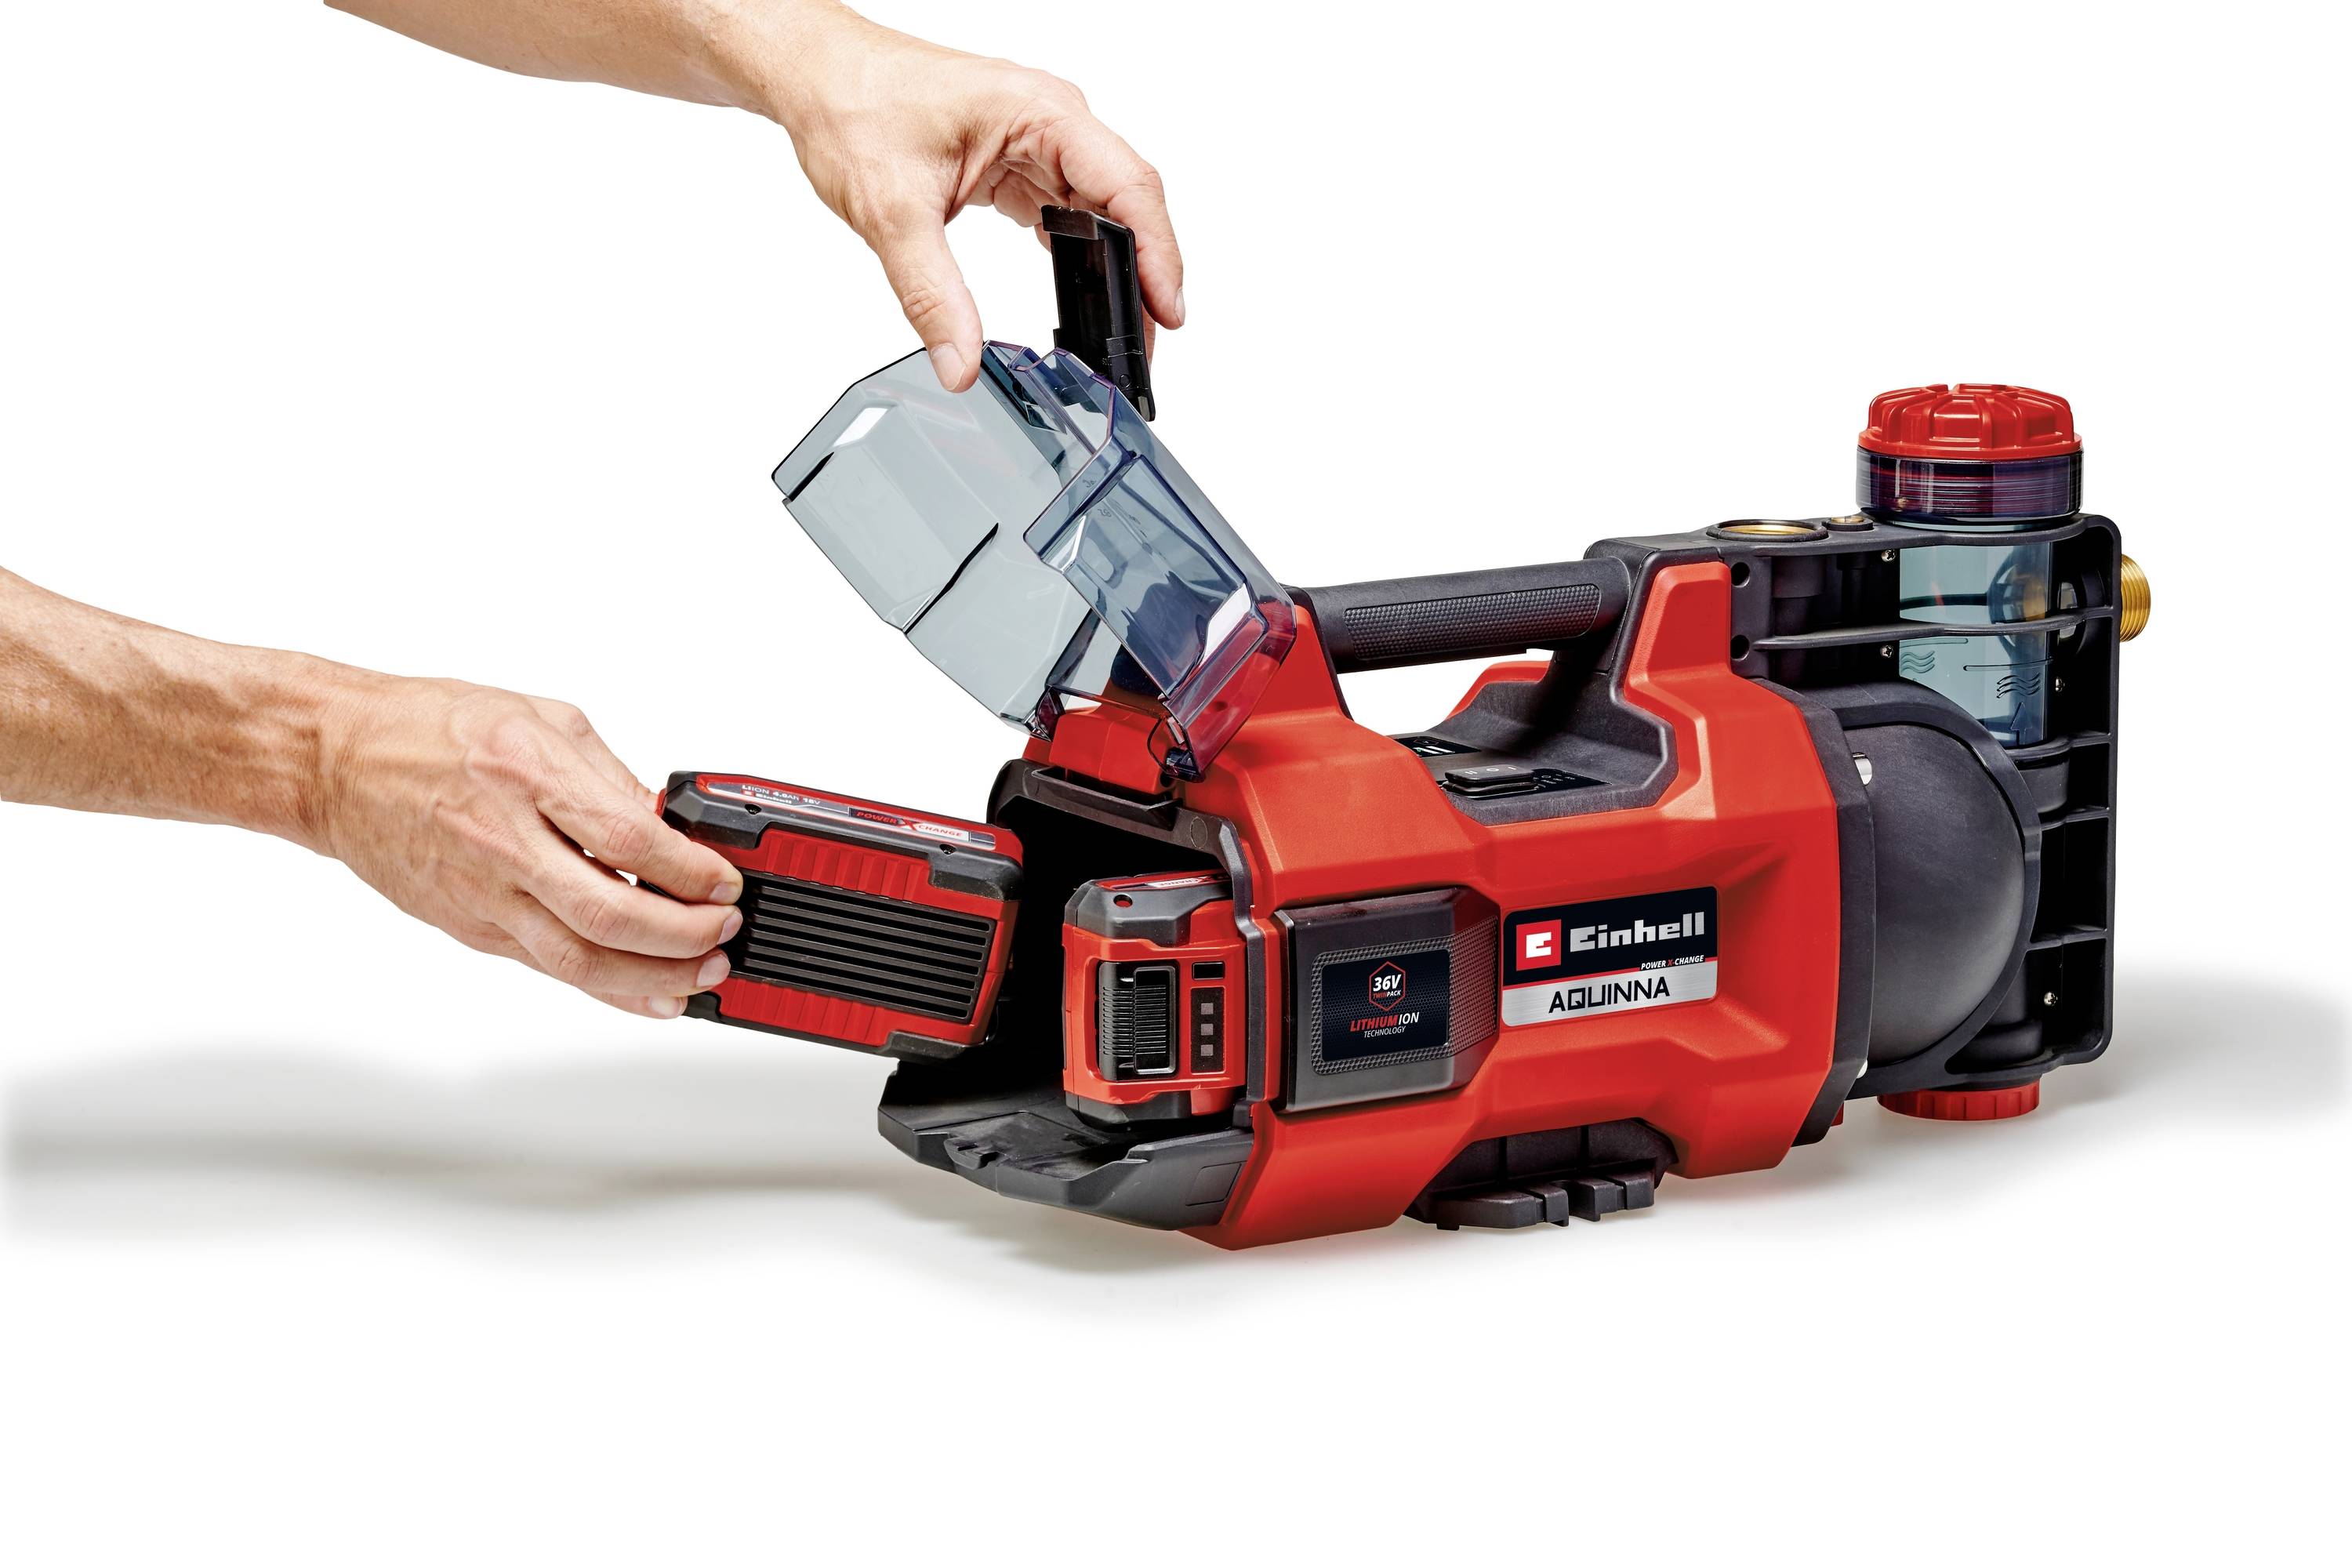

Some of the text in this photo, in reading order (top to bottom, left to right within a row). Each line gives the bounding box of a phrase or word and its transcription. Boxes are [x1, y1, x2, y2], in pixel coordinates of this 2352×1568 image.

[856, 811, 898, 824] POWER
[1570, 911, 1704, 953] Einhell
[1640, 960, 1666, 970] POWER
[1373, 974, 1402, 992] 36V
[1548, 976, 1671, 1014] AQUINNA
[1364, 1025, 1406, 1039] TECHNOLOGY
